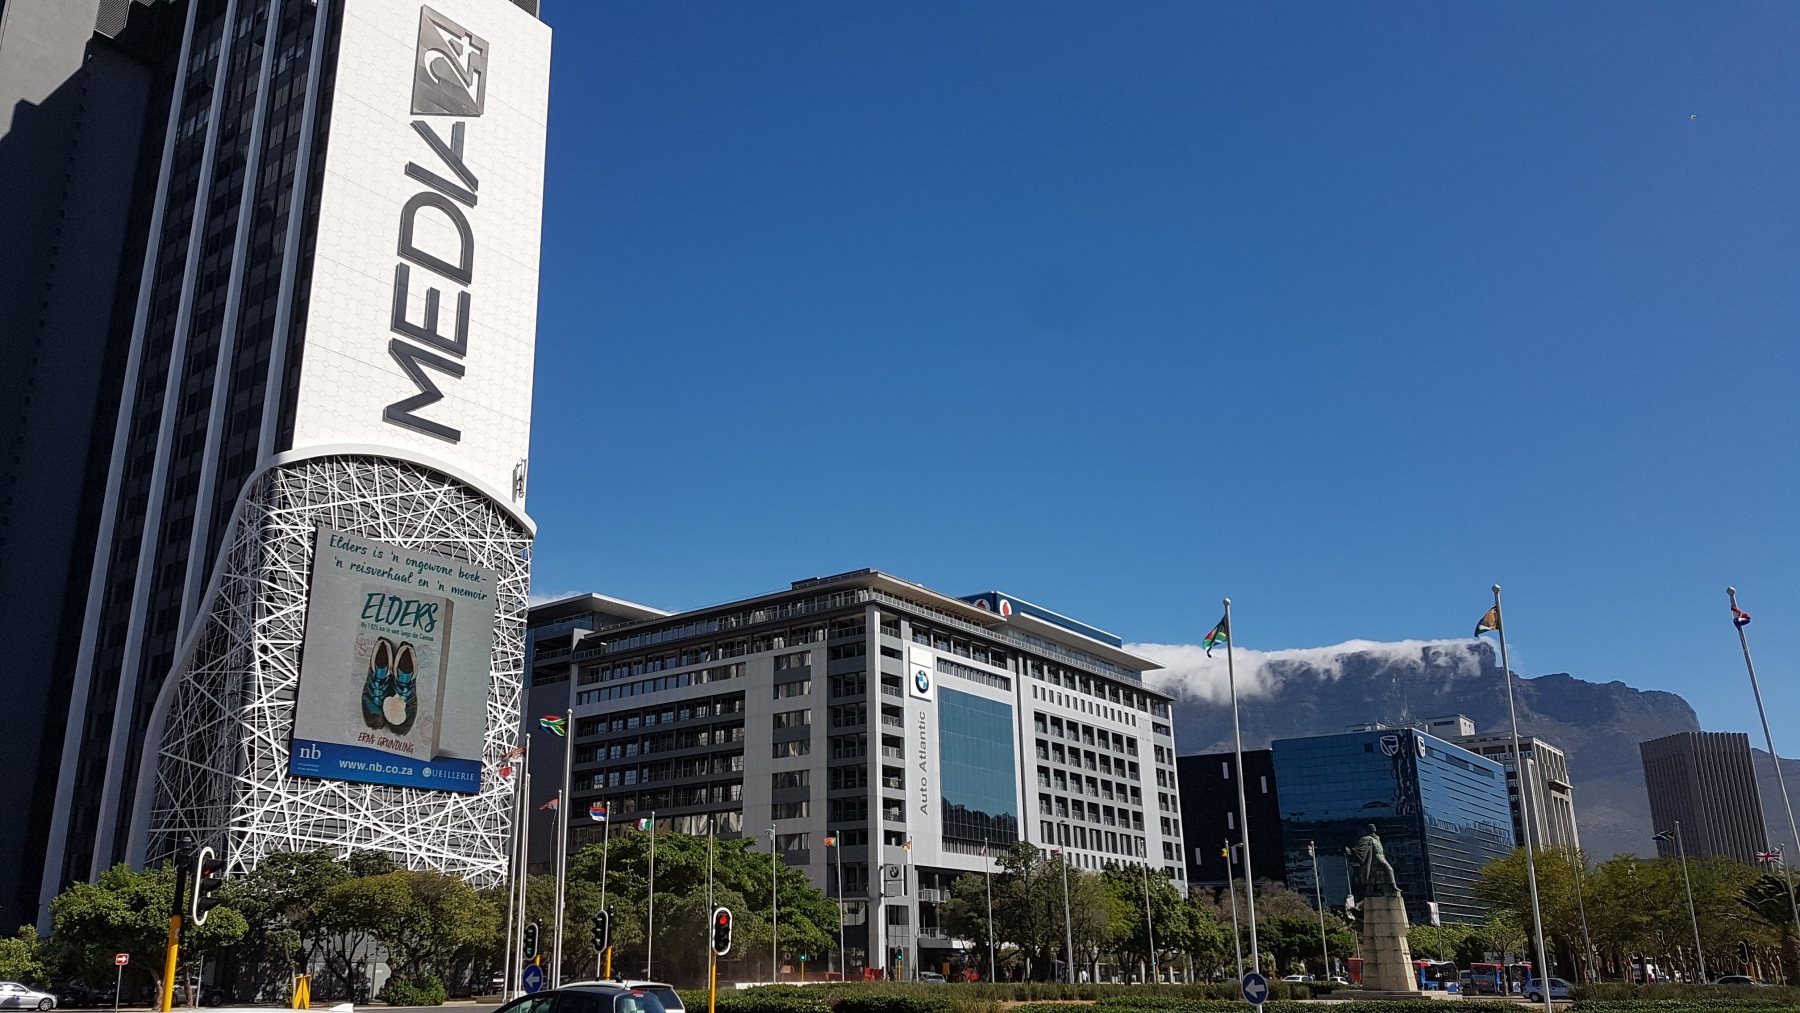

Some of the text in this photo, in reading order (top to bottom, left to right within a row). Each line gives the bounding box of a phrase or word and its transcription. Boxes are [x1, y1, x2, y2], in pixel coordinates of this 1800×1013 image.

[330, 534, 367, 555] Elders
[372, 546, 383, 559] is
[391, 549, 399, 563] 'n
[405, 557, 453, 575] ongewone
[334, 556, 488, 601] 'n reisverhaal en 'n memoir
[361, 593, 439, 633] ELDERS
[299, 743, 322, 760] nb
[338, 759, 413, 776] www.nb.co.za
[917, 711, 928, 816] Auto Atlantic
